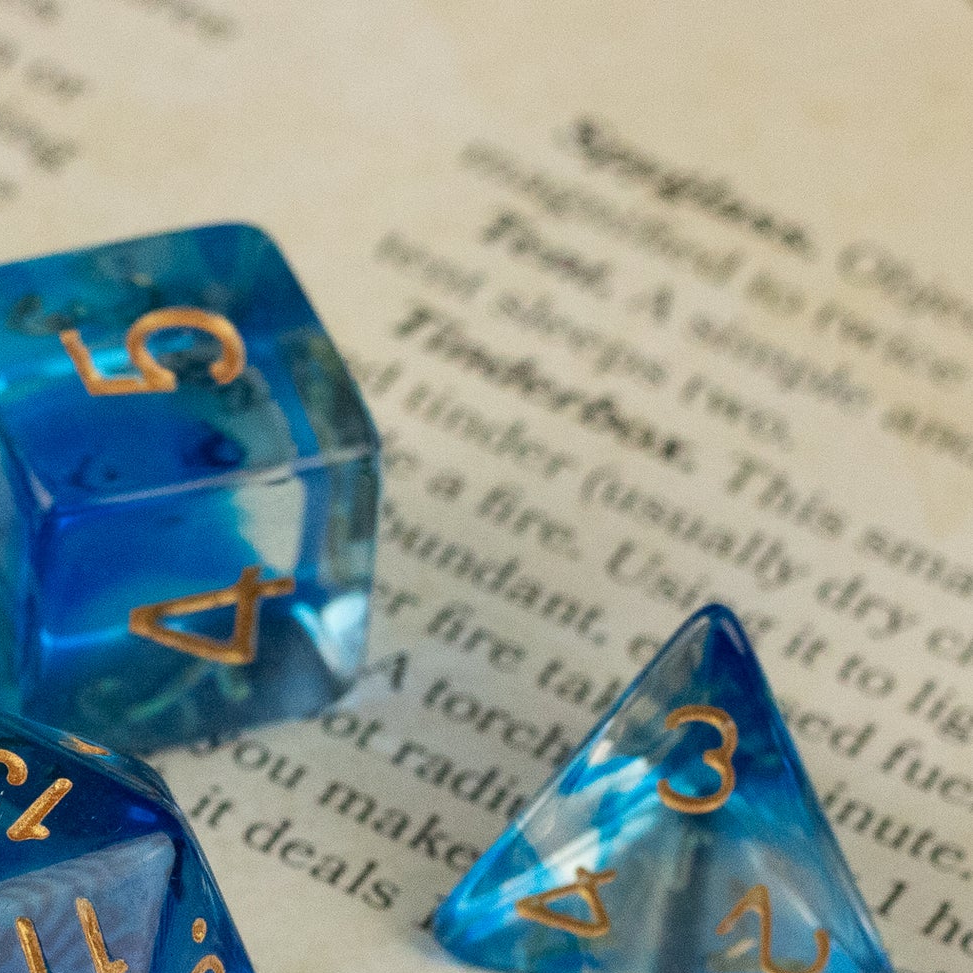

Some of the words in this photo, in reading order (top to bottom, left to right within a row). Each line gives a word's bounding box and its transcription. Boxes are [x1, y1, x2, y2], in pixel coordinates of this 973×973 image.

[724, 453, 850, 540] This
[427, 603, 530, 672] fire
[814, 570, 922, 645] dry
[784, 632, 829, 675] it
[835, 648, 897, 702] to
[656, 704, 738, 814] 3
[189, 785, 234, 832] it
[242, 815, 402, 912] deals
